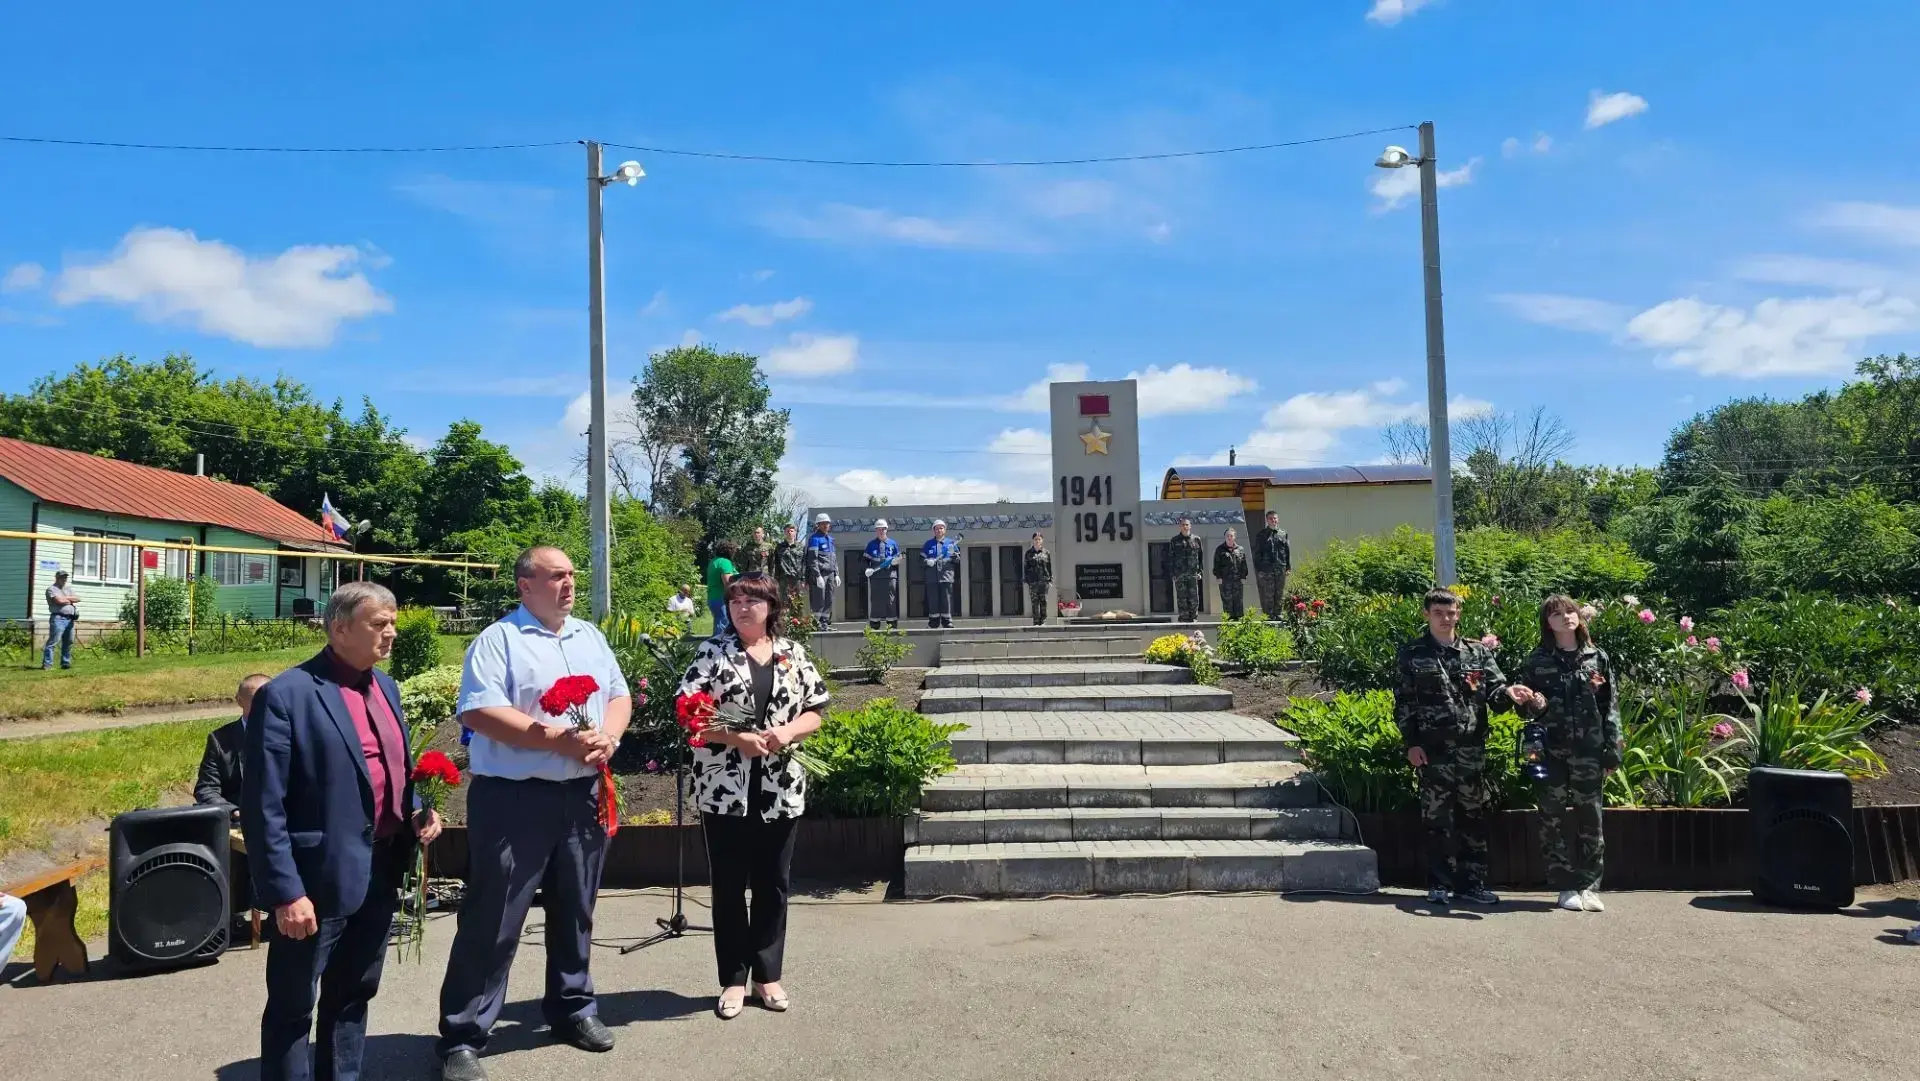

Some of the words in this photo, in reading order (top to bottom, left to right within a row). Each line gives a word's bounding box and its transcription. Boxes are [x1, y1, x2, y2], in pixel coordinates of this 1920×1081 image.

[1060, 475, 1112, 506] 1941
[1074, 511, 1134, 543] 1945
[165, 939, 186, 948] Audio
